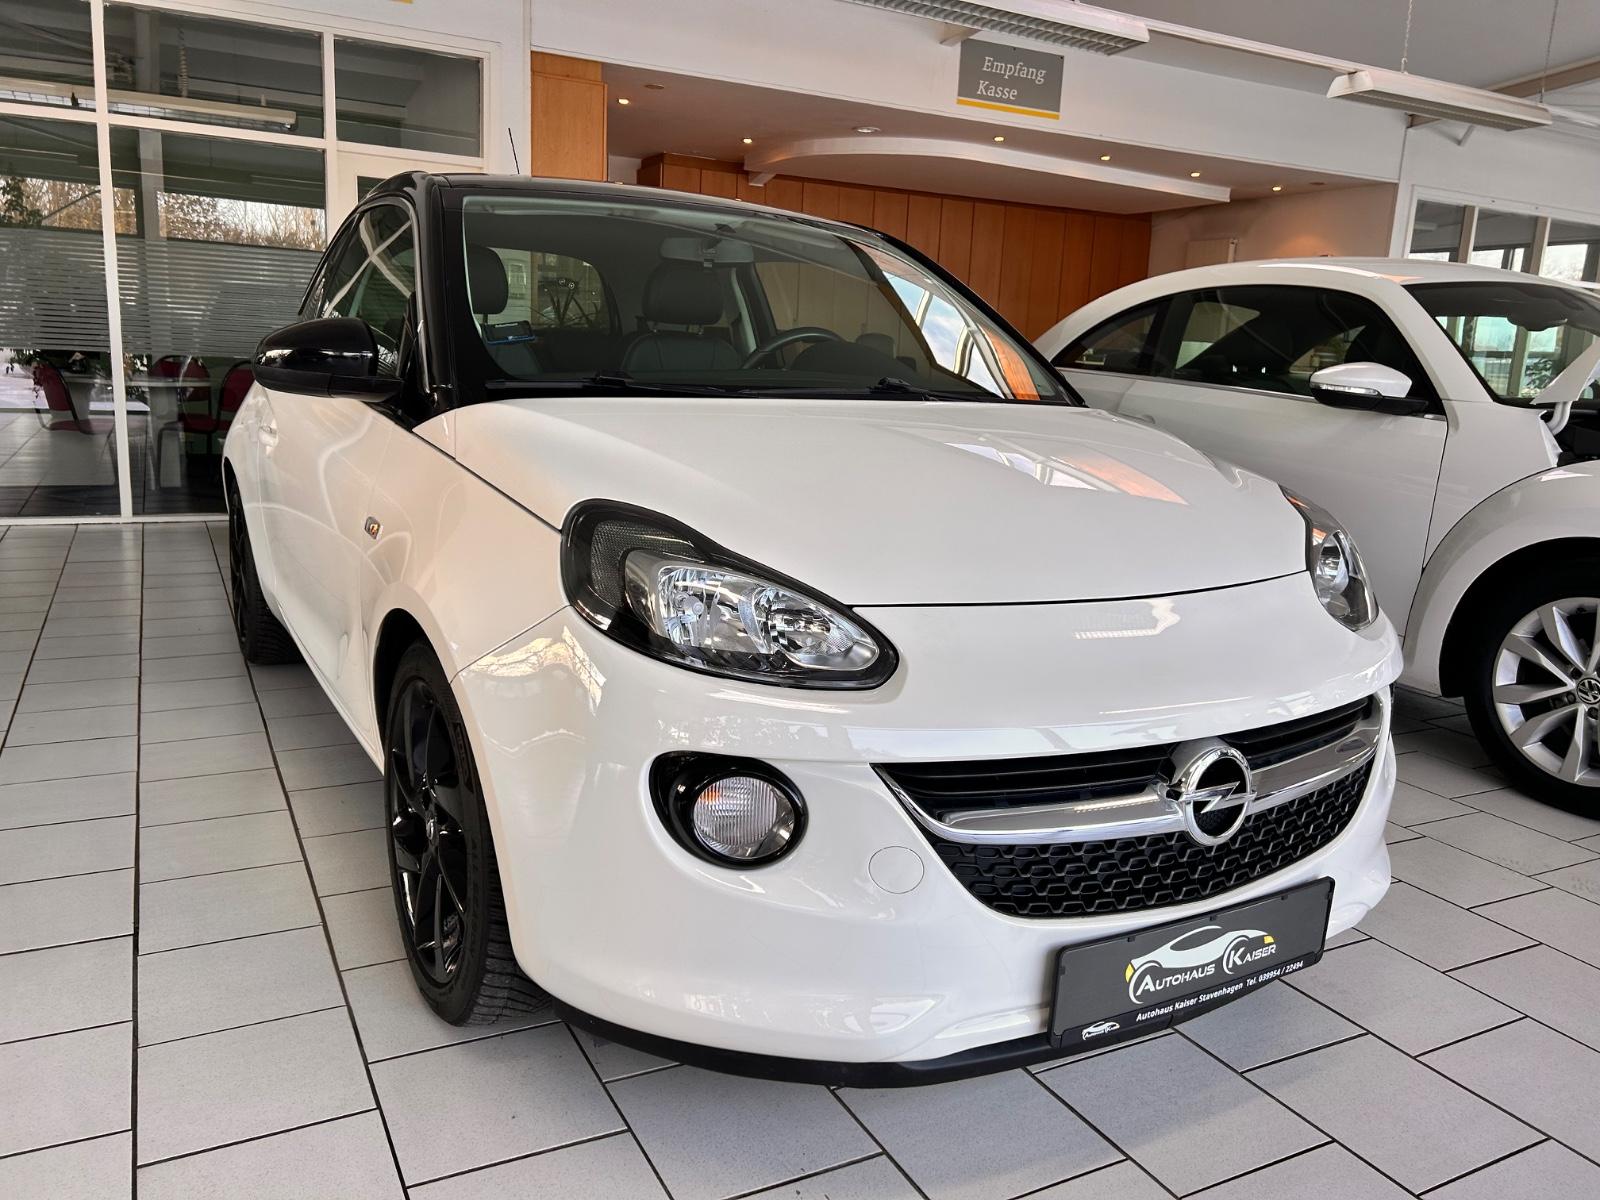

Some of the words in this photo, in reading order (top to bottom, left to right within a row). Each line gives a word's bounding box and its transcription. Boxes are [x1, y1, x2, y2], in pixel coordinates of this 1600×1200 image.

[976, 80, 1018, 100] Kasse
[982, 56, 1047, 85] Empfang
[1136, 963, 1216, 996] AUTOHAUS
[1228, 944, 1277, 969] KAISER
[1135, 1004, 1174, 1022] Autohaus
[1174, 997, 1199, 1011] Kaiser
[1198, 982, 1244, 1003] Stavenhagen
[1246, 977, 1257, 987] Tel.
[1258, 968, 1281, 983] 039954
[1285, 960, 1304, 974] 22494
